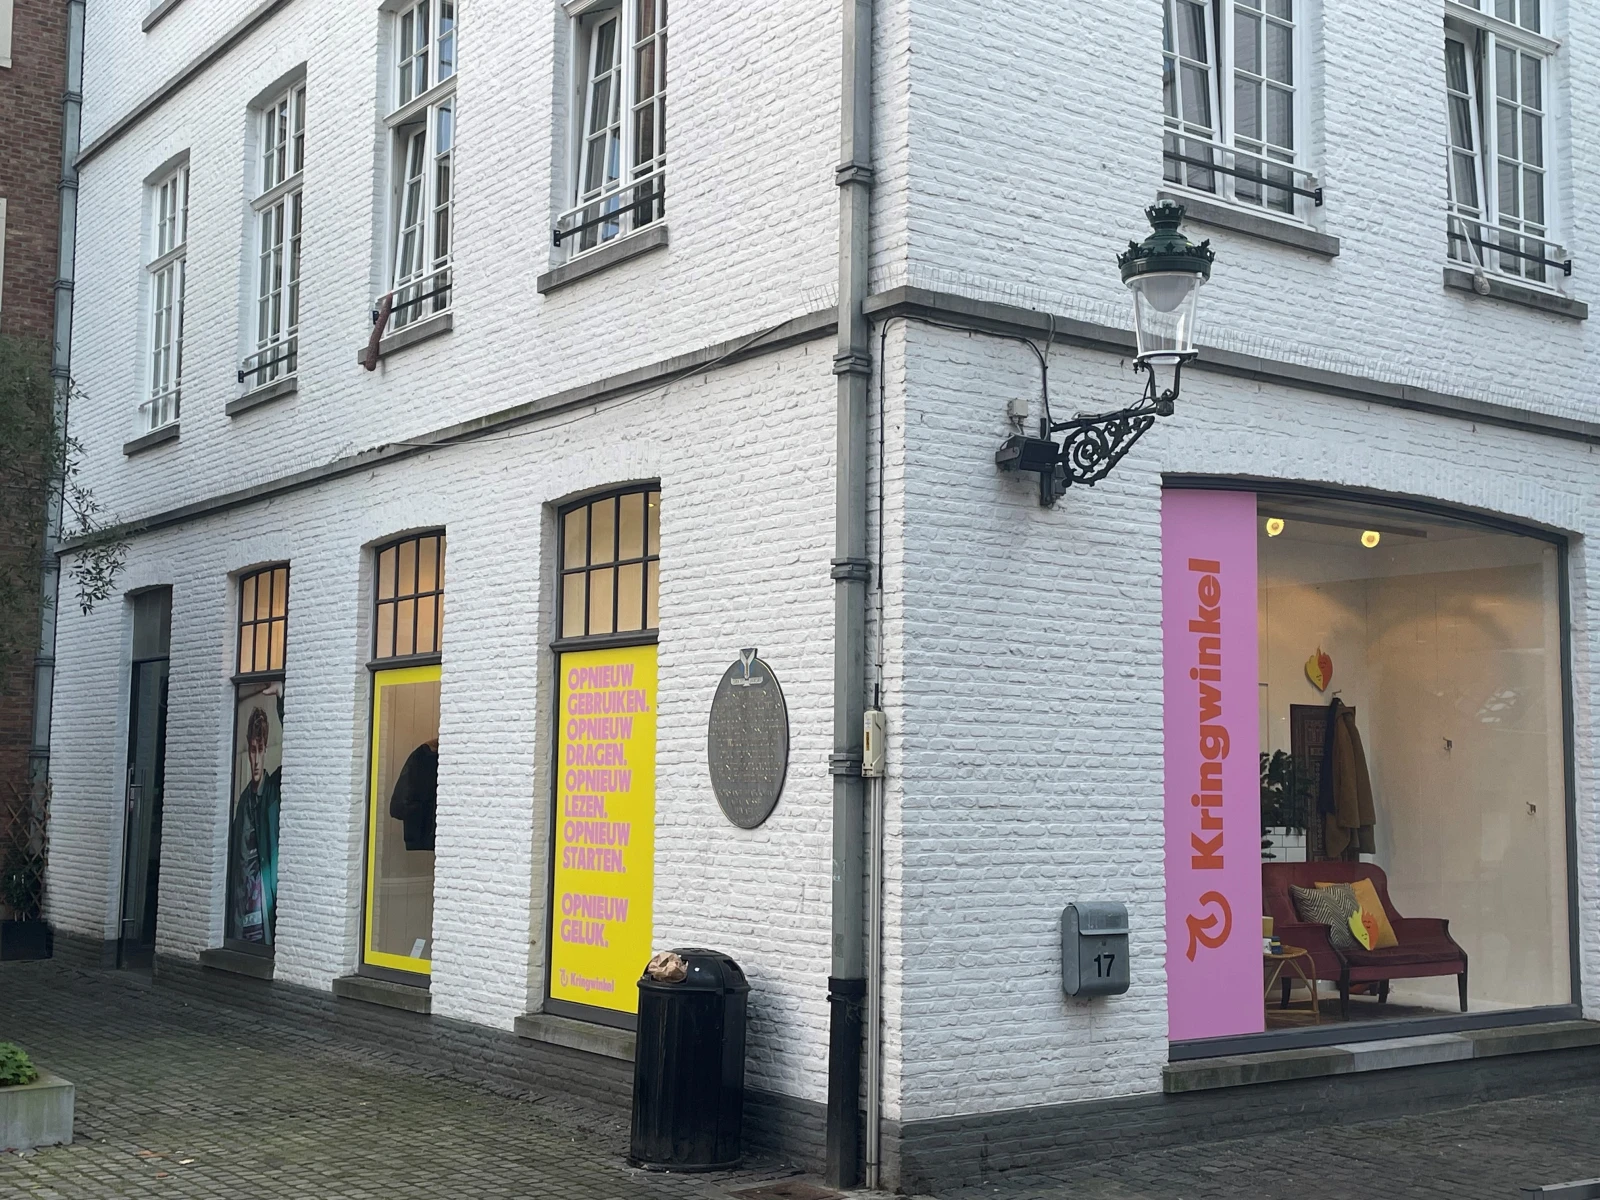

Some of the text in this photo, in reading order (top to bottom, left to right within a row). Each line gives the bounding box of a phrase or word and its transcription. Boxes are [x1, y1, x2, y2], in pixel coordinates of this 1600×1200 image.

[568, 664, 634, 690] OPNIEUW
[567, 689, 650, 715] GEBRUIKEN.
[1188, 557, 1231, 870] Kringwinkel
[567, 717, 633, 741] OPNIEUW
[566, 743, 627, 766] DRAGEN.
[565, 769, 632, 793] OPNIEUW
[564, 794, 608, 818] LEZEN.
[563, 820, 631, 846] OPNIEUW
[562, 846, 626, 873] STARTEN.
[561, 893, 629, 922] OPNIEUW
[560, 918, 608, 947] GELUK.
[1093, 954, 1116, 978] 17
[570, 973, 615, 993] Kringwinkel
